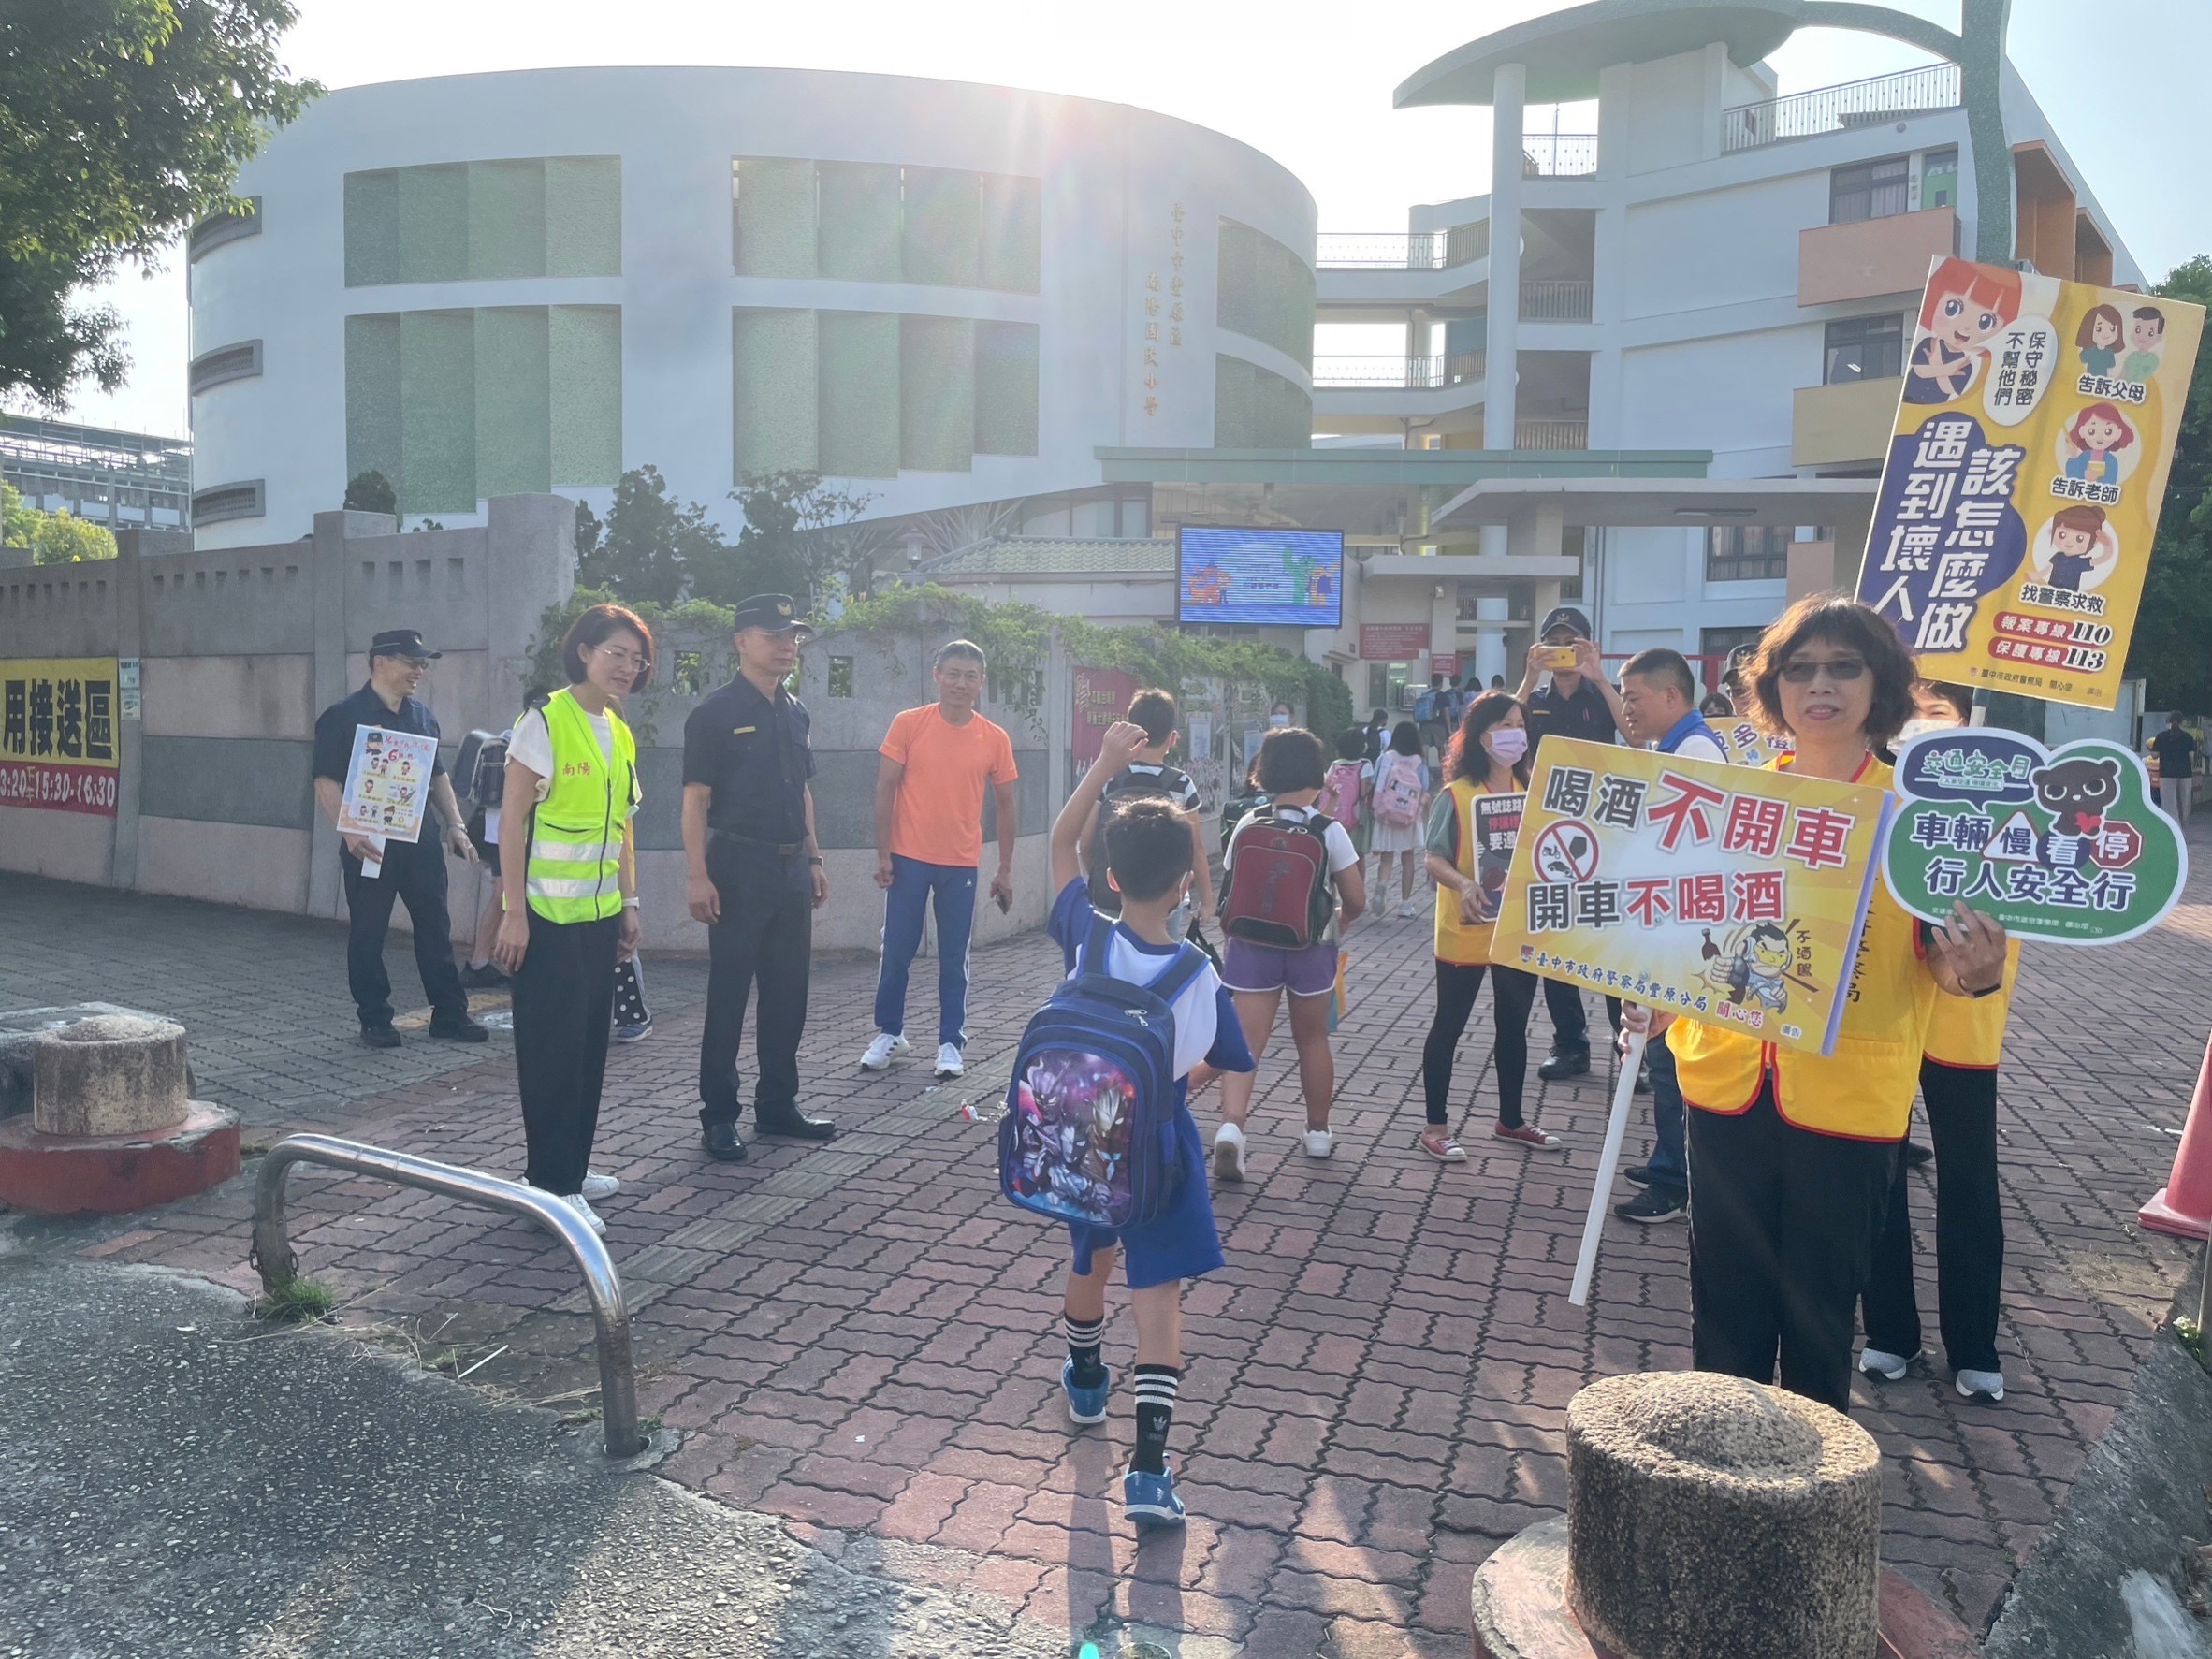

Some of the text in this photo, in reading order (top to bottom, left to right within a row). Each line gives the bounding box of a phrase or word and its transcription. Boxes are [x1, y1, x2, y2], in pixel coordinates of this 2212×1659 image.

[1993, 331, 2023, 406] 不幫他們
[2016, 331, 2046, 406] 保守秘密
[2078, 375, 2146, 401] 告訴父母
[2051, 478, 2118, 503] 告訴老師
[1873, 421, 1972, 622] 遇到壞人
[1914, 448, 2020, 650] 該怎麼做
[2020, 584, 2103, 615] 找警察求救
[1996, 640, 2104, 669] 保護專線 113
[2001, 615, 2111, 643] 報案專線 110
[4, 678, 112, 760] 用接送區
[562, 762, 591, 776] 南陽
[1921, 749, 2031, 779] 交通安全月
[1481, 798, 1525, 815] 無號誌路
[1542, 766, 1854, 869] 喝酒不開車
[1528, 871, 1783, 932] 開車不喝酒
[1927, 858, 2135, 910] 行人安全行
[1536, 954, 1764, 1027] 臺中市政府警察局豐原分局 關心您
